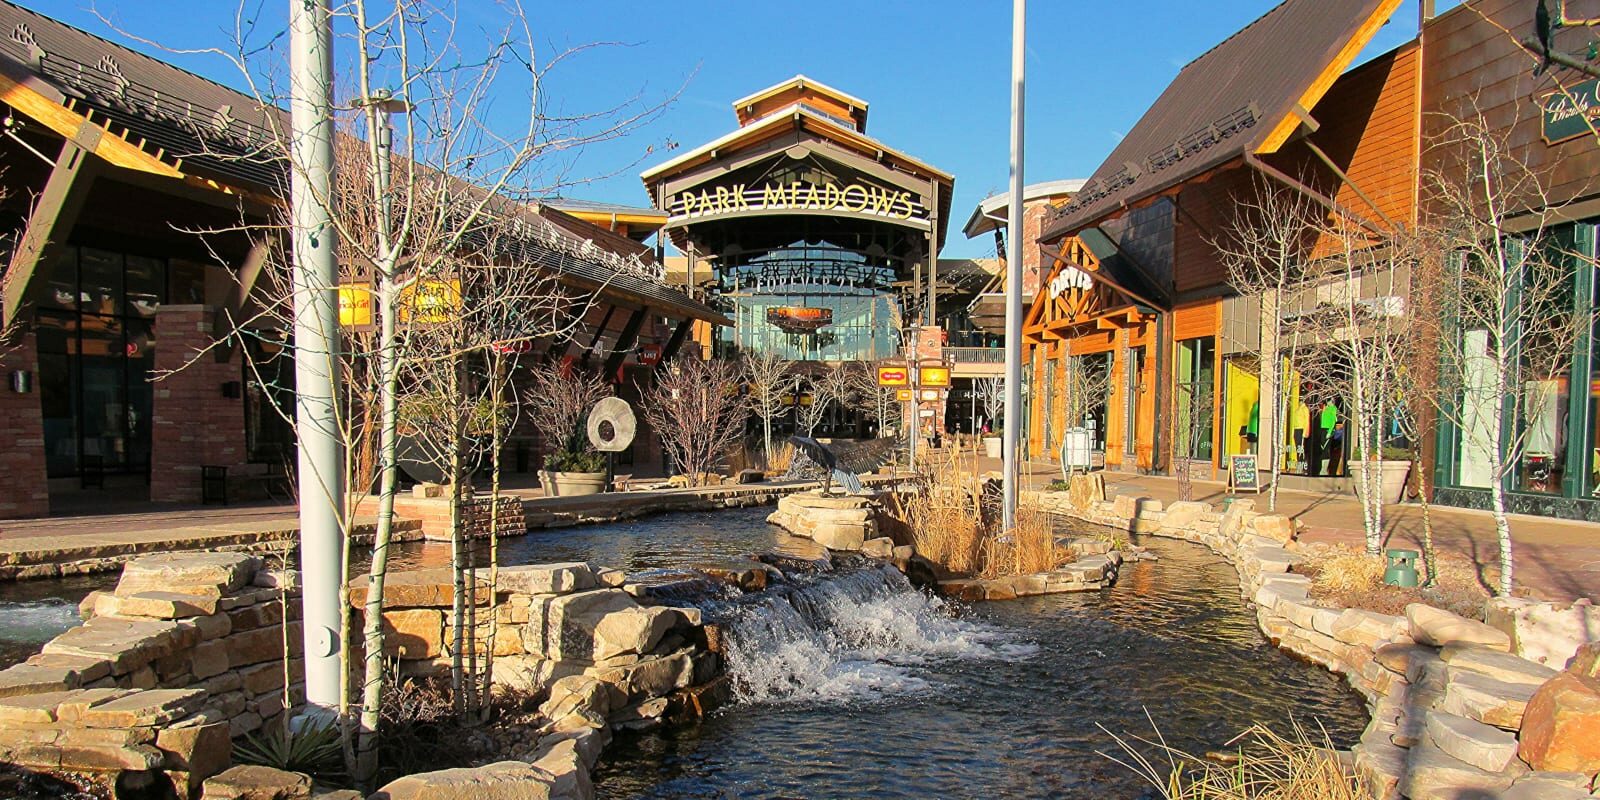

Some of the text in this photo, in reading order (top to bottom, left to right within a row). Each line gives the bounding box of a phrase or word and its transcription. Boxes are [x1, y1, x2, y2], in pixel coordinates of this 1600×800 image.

[682, 181, 913, 219] PARK MEADOWS
[757, 276, 854, 293] FOREVER 21
[1050, 266, 1092, 299] ORVIS
[357, 299, 369, 308] Girl
